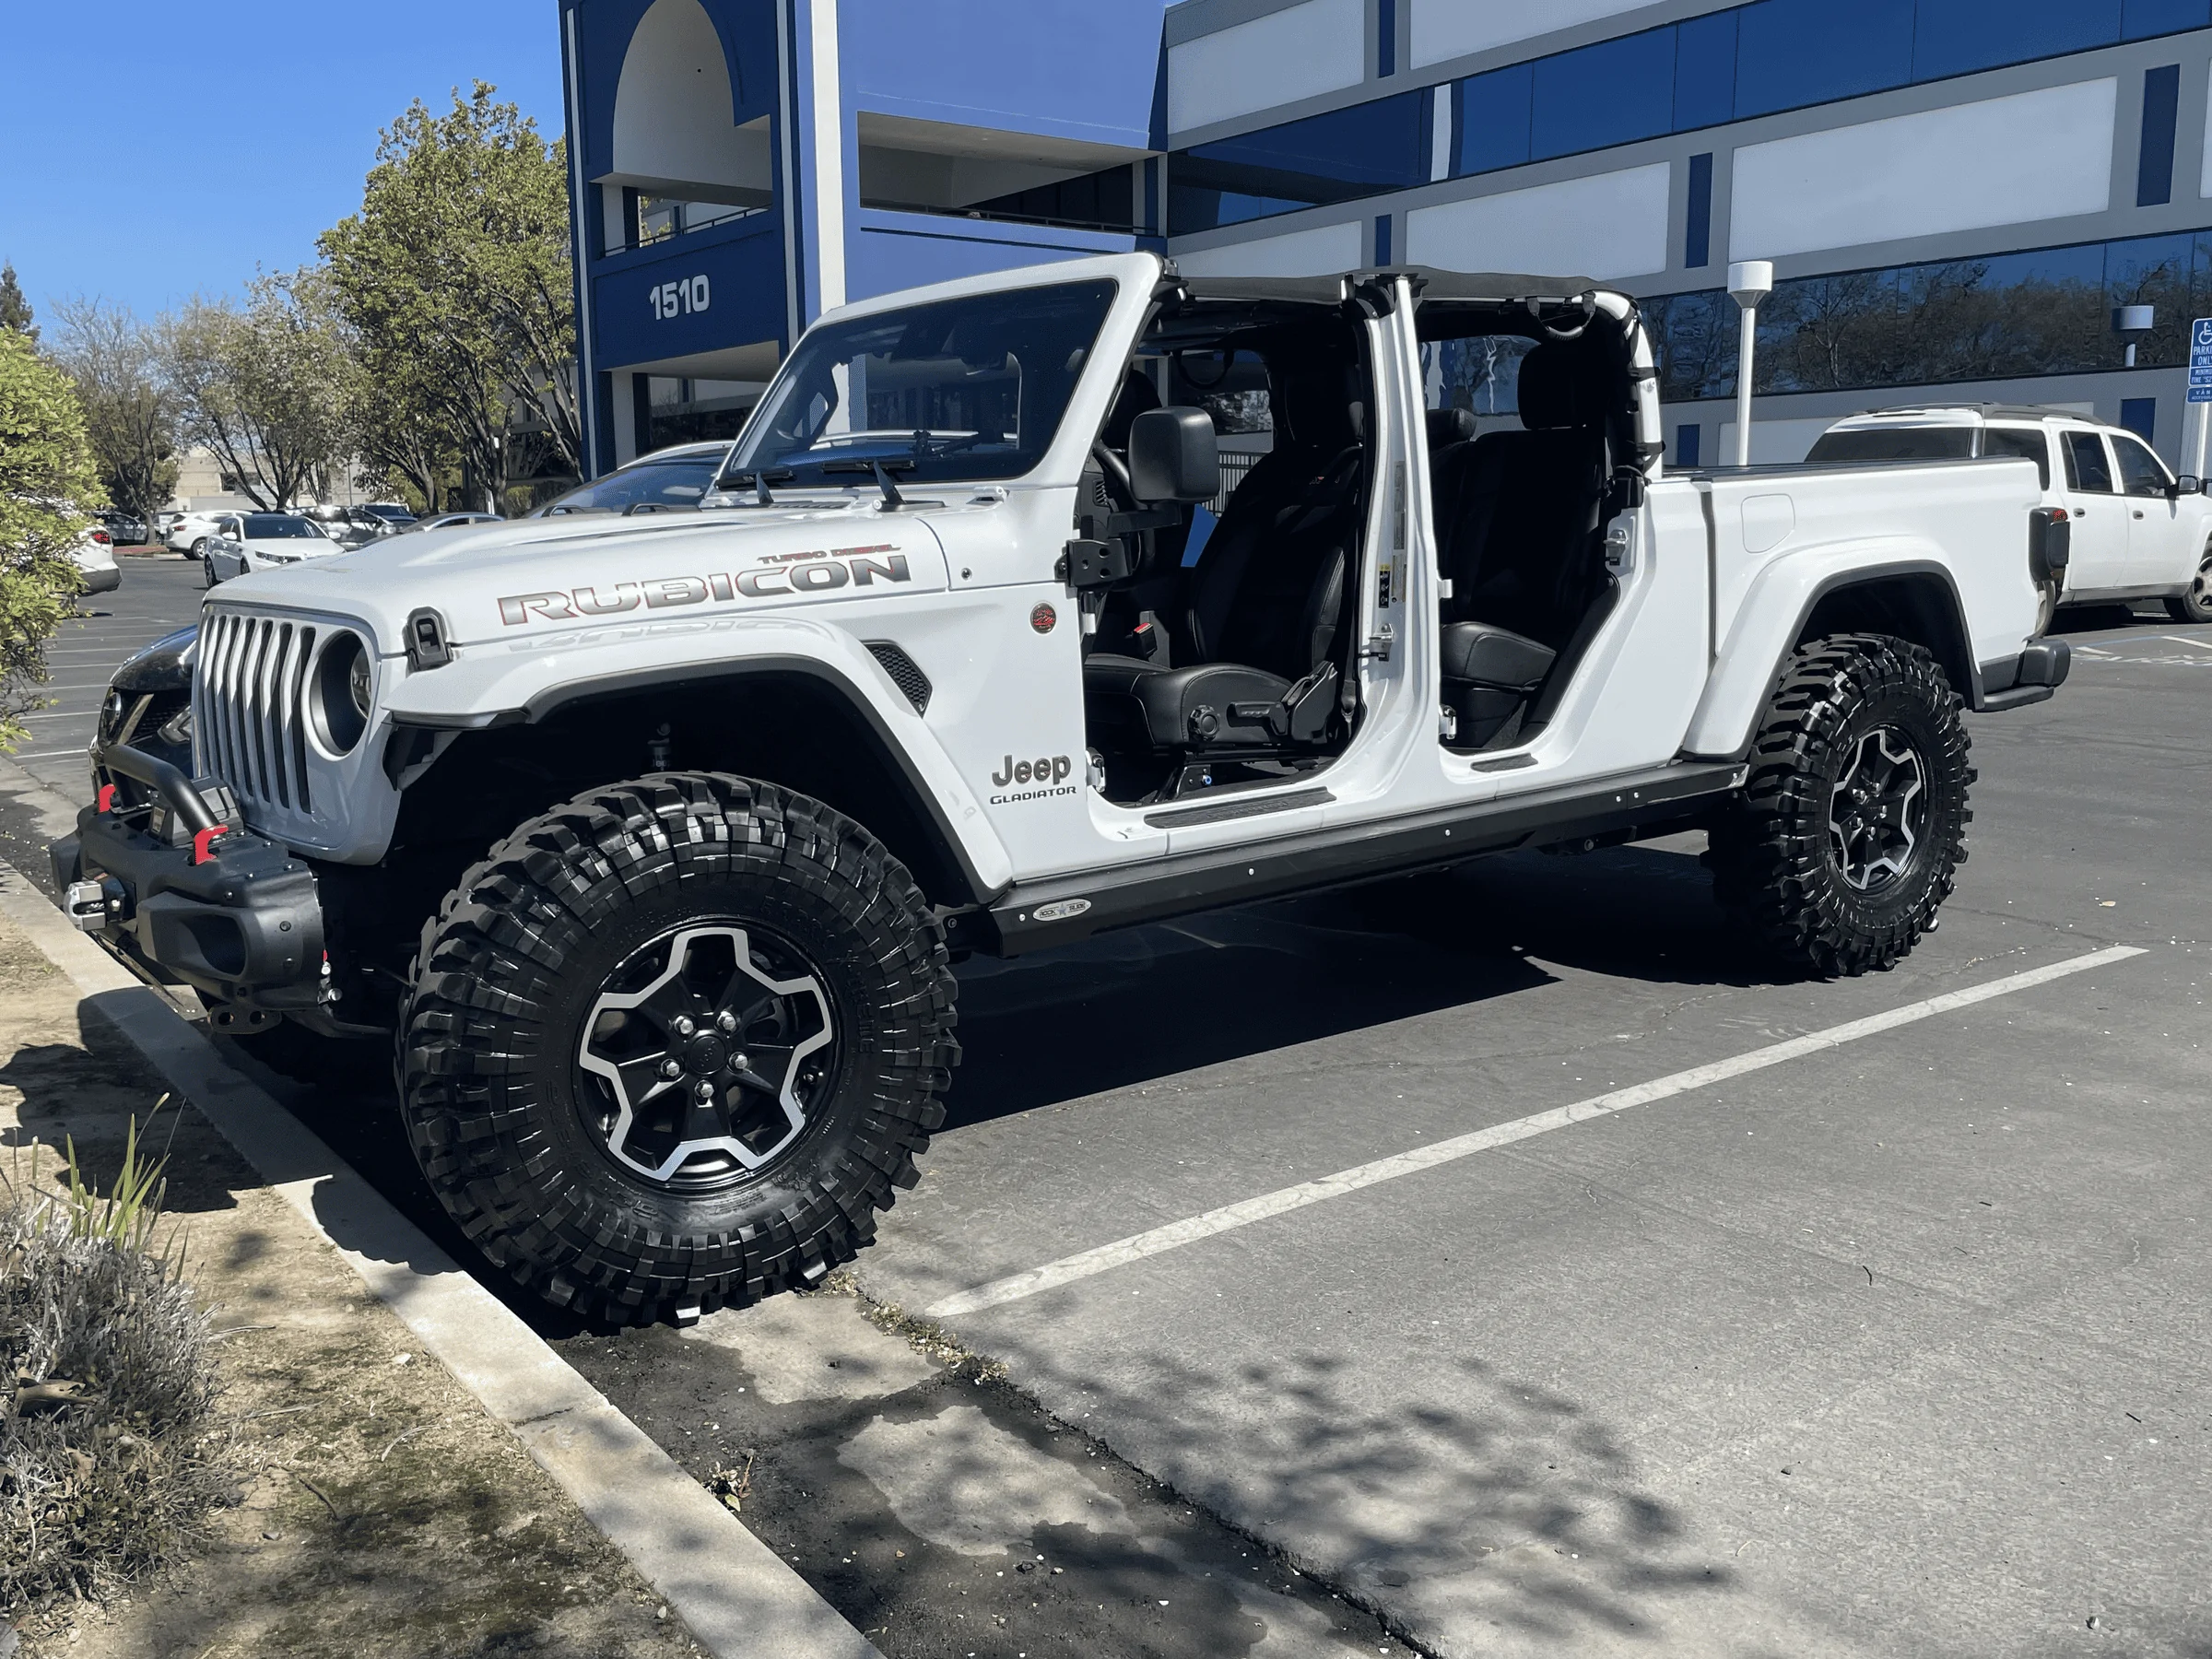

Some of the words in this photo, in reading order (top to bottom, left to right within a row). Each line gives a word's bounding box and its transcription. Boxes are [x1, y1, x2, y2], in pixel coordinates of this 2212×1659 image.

[650, 274, 711, 321] 1510
[757, 550, 828, 565] TURBO
[830, 544, 902, 558] DIESEL
[498, 555, 912, 627] RUBICON
[992, 754, 1071, 786] Jeep
[989, 786, 1077, 806] GLADIATOR
